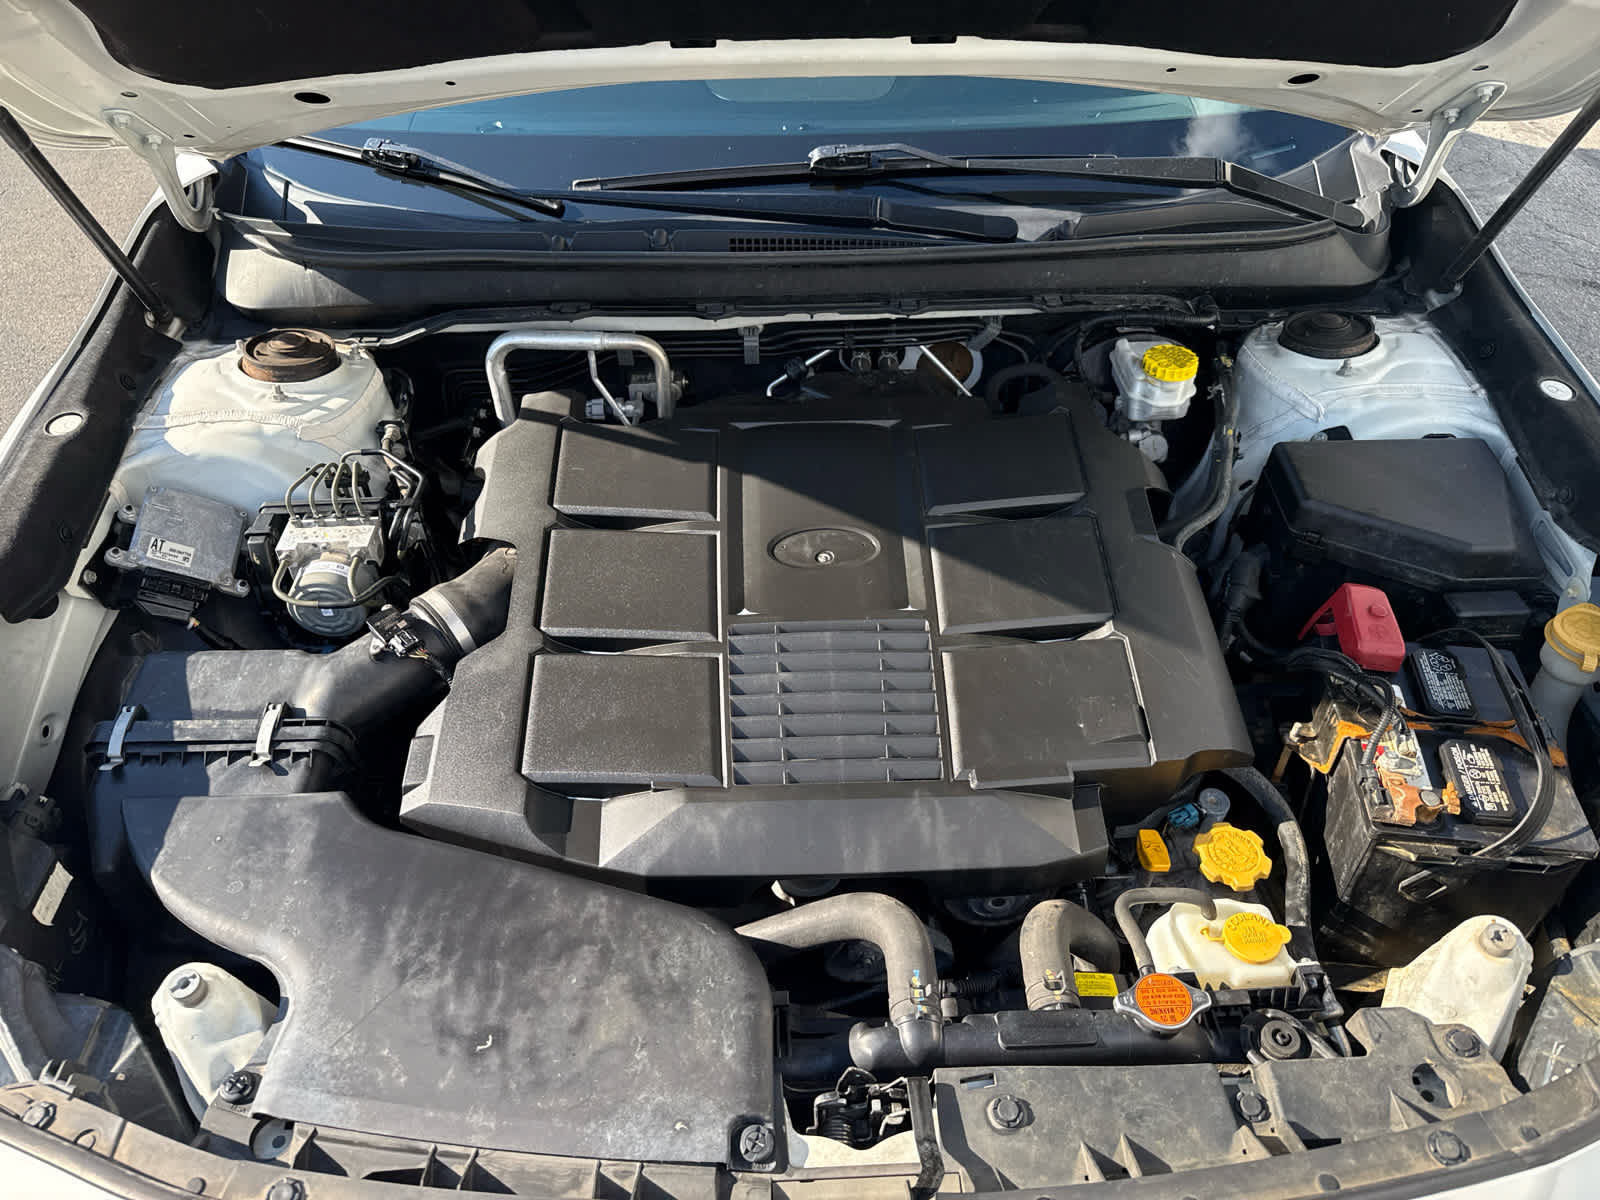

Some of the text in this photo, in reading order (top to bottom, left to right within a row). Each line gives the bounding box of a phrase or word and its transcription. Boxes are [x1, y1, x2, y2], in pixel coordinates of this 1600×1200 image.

[151, 538, 166, 554] AT
[1449, 746, 1464, 769] POISON
[1460, 775, 1476, 801] DANGER
